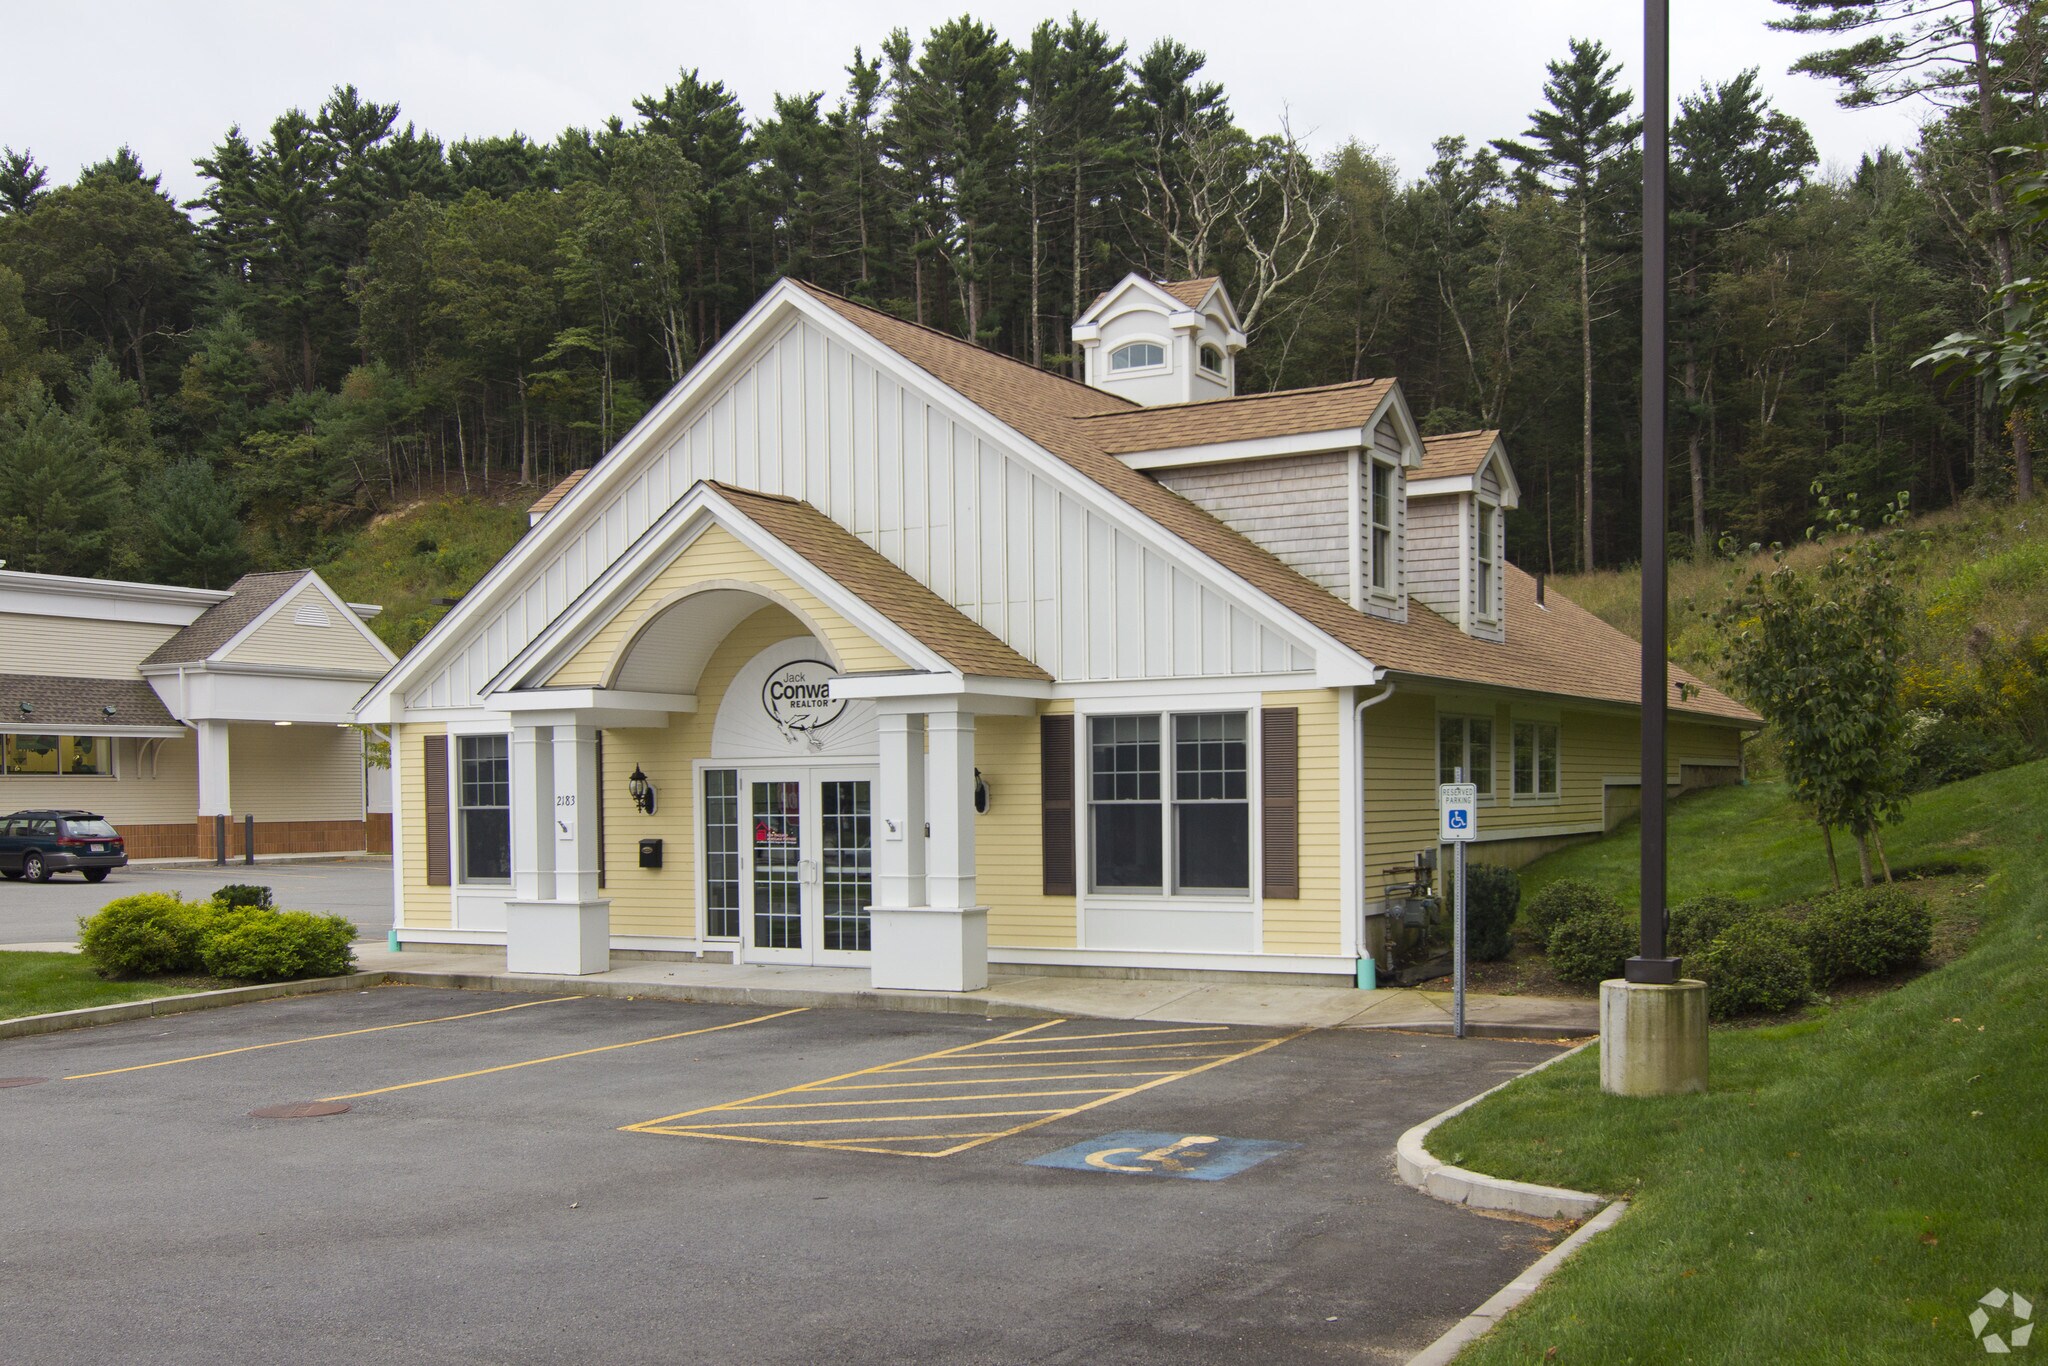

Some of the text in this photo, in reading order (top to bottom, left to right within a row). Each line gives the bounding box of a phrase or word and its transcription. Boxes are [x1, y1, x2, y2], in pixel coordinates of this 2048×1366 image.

[783, 672, 806, 683] Jack
[770, 681, 836, 703] Conwa
[790, 700, 829, 708] REALTOR
[1443, 788, 1473, 796] RESERVED
[556, 795, 576, 807] 2183
[1446, 796, 1472, 804] PARKING
